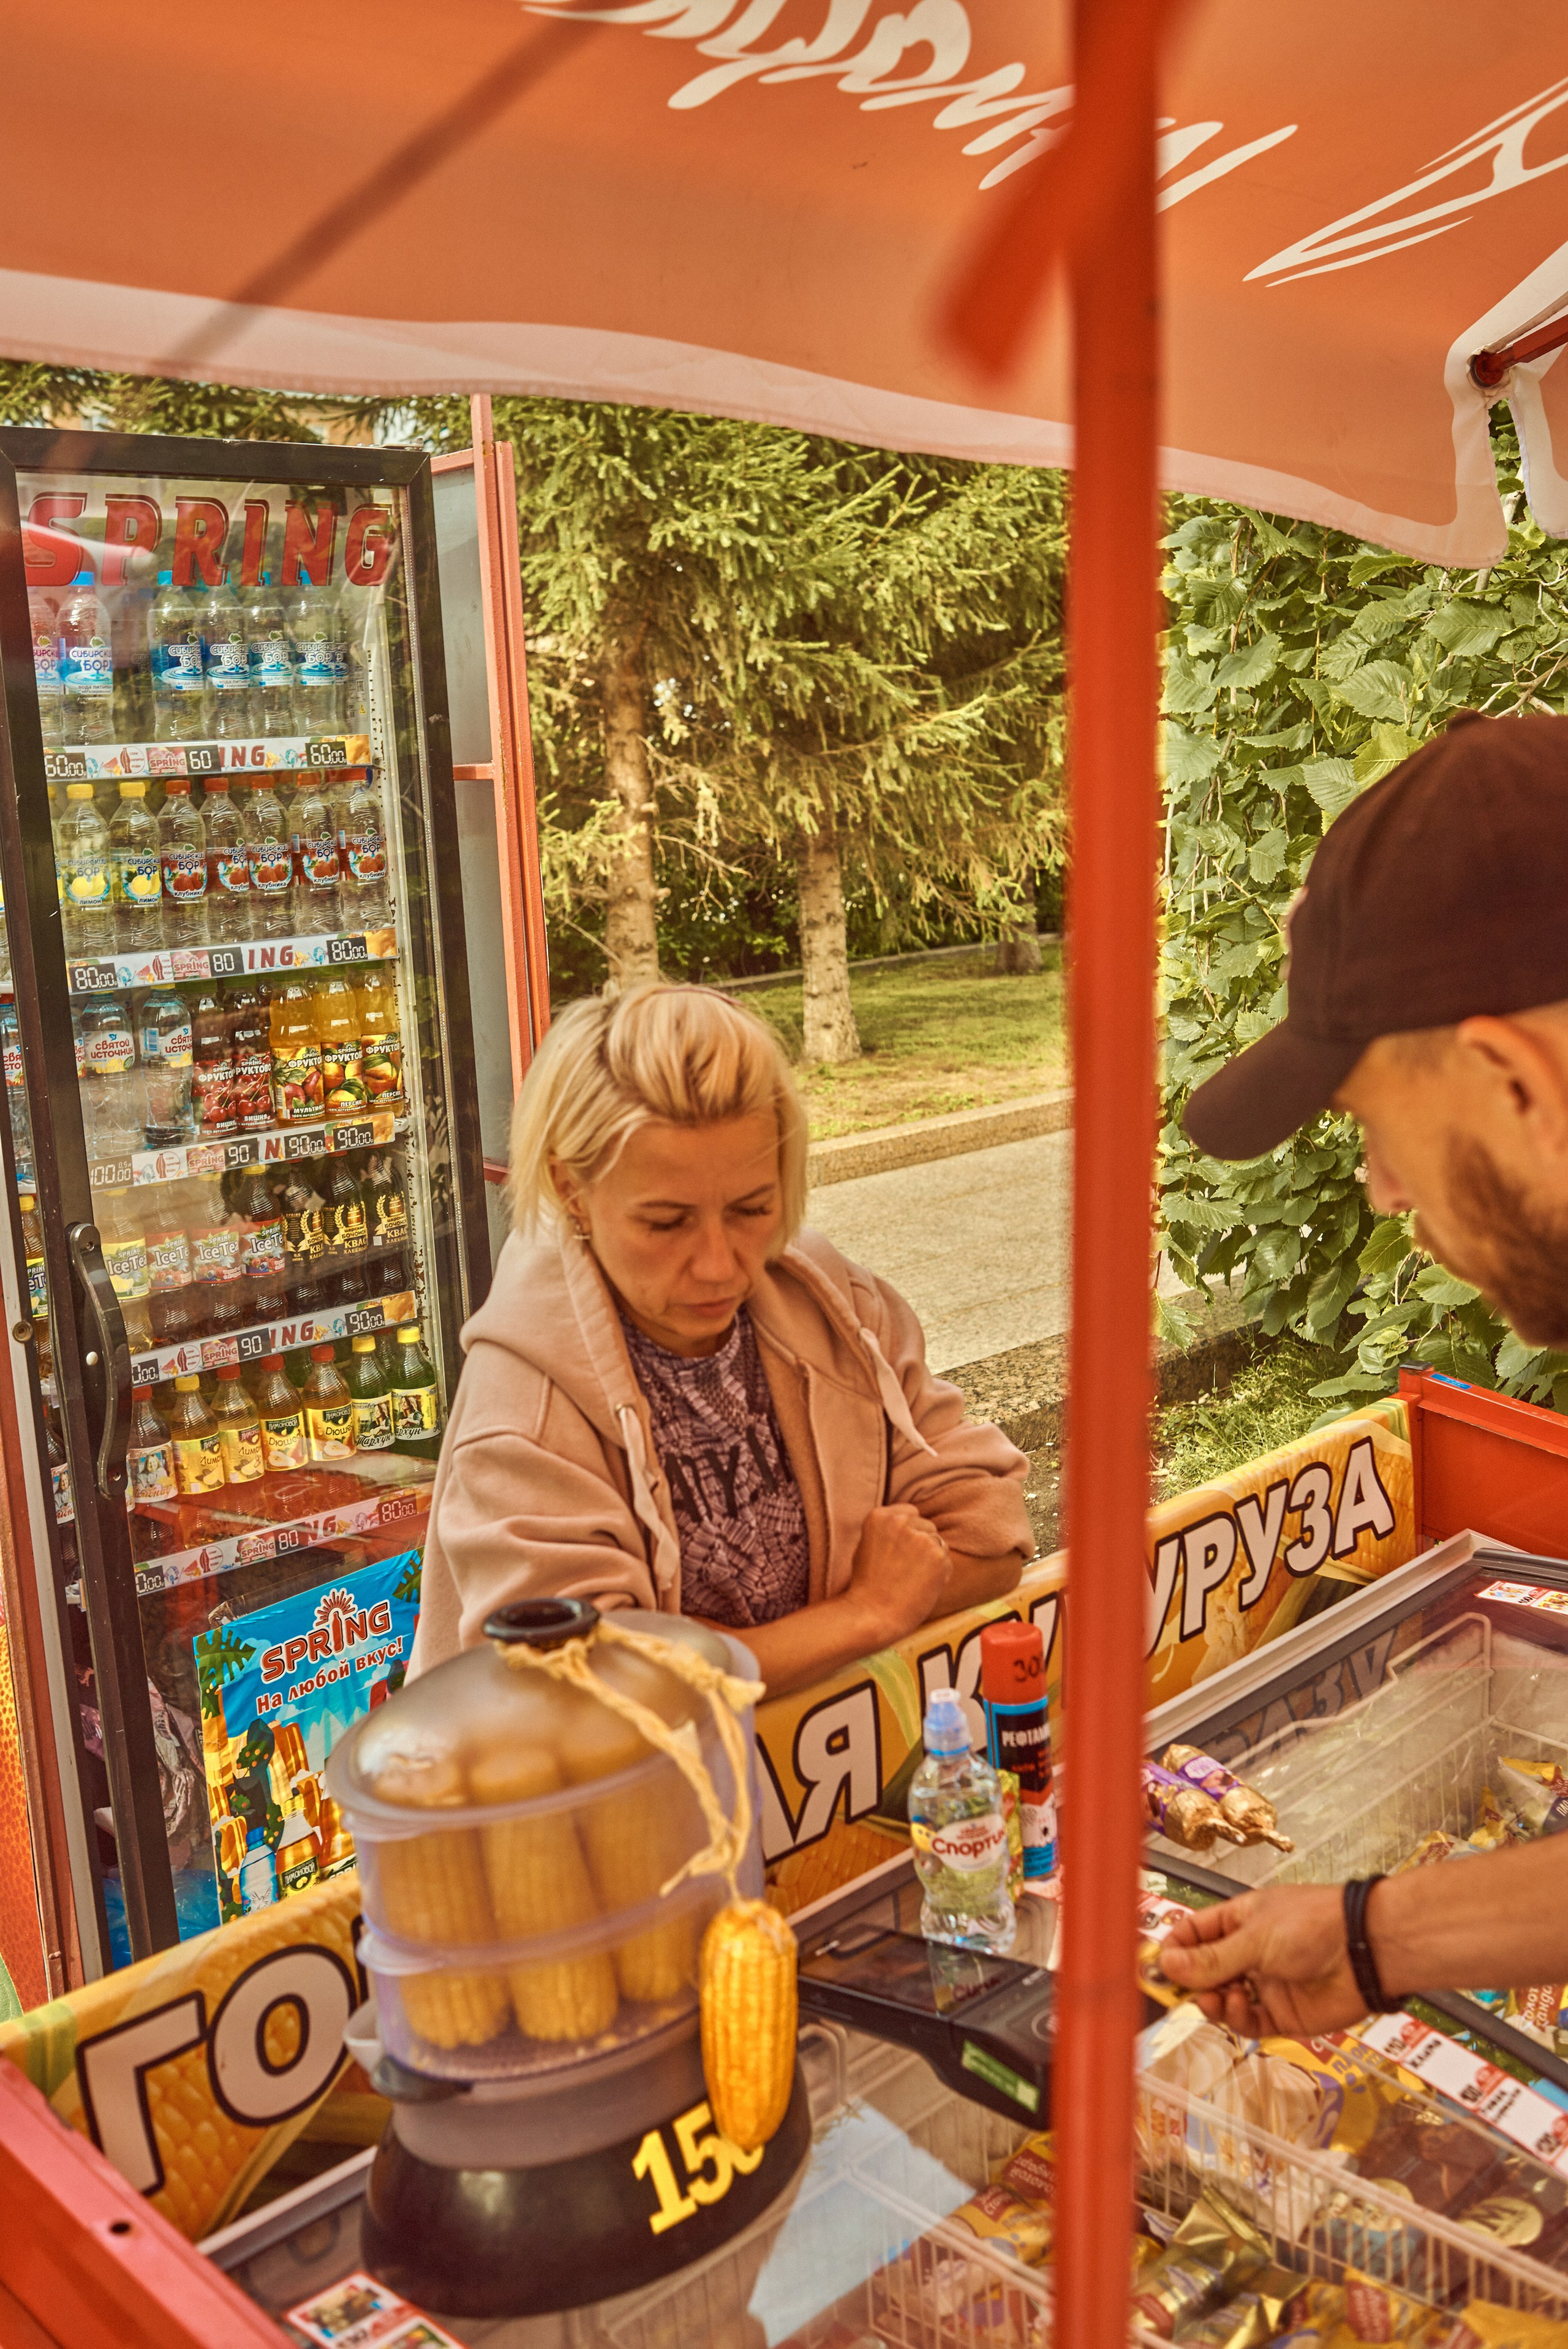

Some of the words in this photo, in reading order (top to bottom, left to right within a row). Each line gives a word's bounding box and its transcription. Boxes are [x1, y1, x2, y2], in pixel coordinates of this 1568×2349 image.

[26, 492, 392, 586] SPRING
[149, 756, 185, 768] SPRING
[190, 750, 212, 769] 60
[361, 843, 380, 854] БОР
[260, 853, 282, 862] БОР
[77, 867, 100, 877] БОР
[137, 866, 157, 875] БОР
[178, 861, 199, 871] БОР
[174, 961, 209, 972] SPRING
[213, 953, 234, 972] 80
[366, 1043, 400, 1054] ФРУКТО
[288, 1056, 322, 1068] ФРУКТО
[325, 1051, 363, 1062] ФРУКТОВ
[198, 1070, 234, 1082] ФРУКТО
[229, 1145, 249, 1164] 90
[189, 1156, 224, 1168] SPRING
[208, 1234, 231, 1244] SPRING
[241, 1336, 262, 1355] 90
[203, 1348, 238, 1362] SPRING
[279, 1529, 298, 1550] 80
[241, 1542, 275, 1558] SPRING
[261, 1602, 390, 1683] SPRING
[257, 1692, 282, 1715] На
[288, 1661, 350, 1702] любой
[356, 1637, 403, 1676] вкус!
[284, 1861, 315, 1885] ЛИМОНОВОЙ
[631, 2102, 764, 2235] 15
